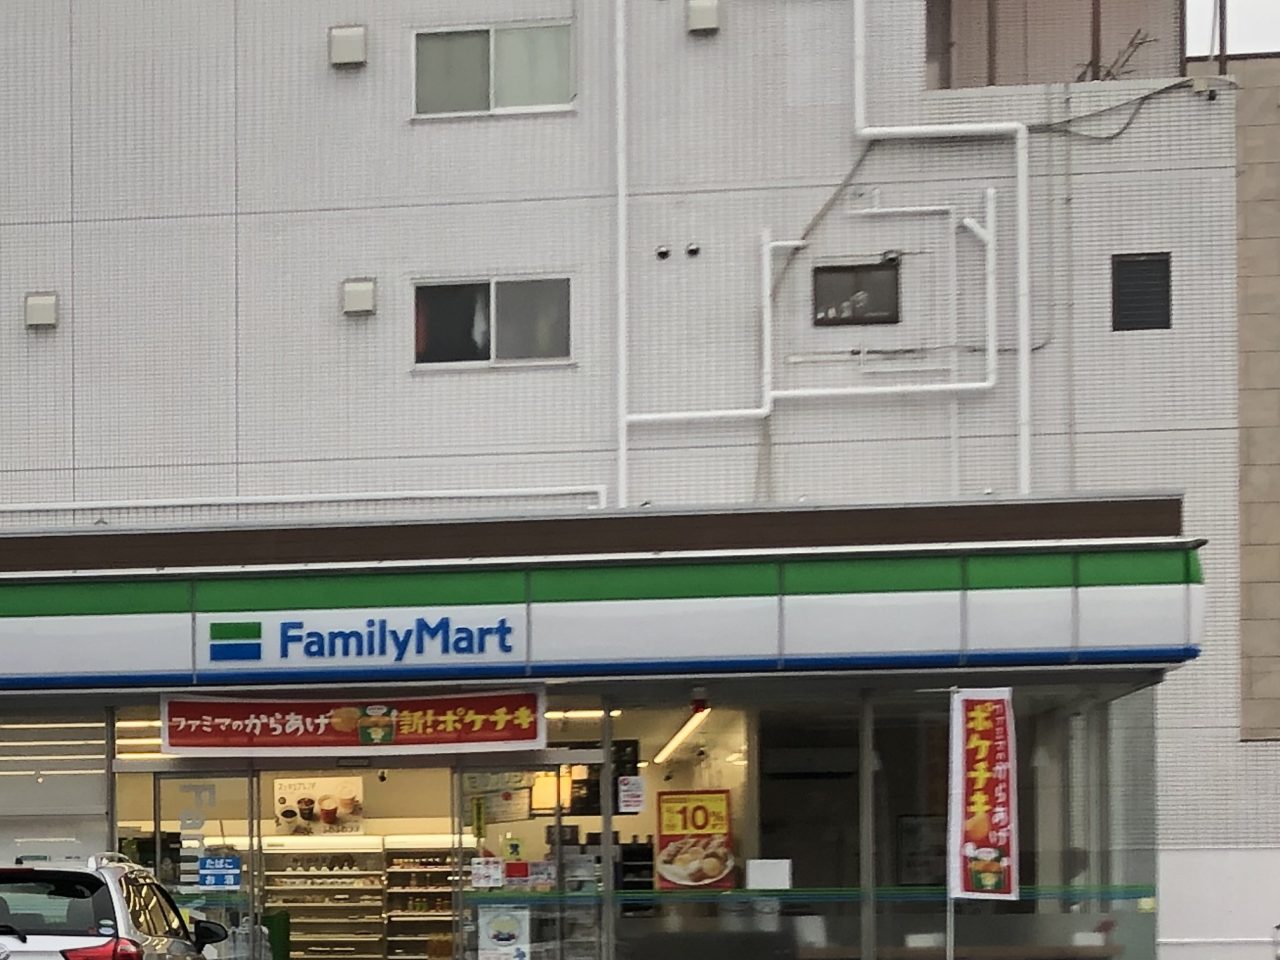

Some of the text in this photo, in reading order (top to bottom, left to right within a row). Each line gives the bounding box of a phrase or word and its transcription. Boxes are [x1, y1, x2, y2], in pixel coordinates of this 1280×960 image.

[280, 617, 513, 661] FamilyMart
[172, 711, 331, 737] ファミマのからあげ
[966, 702, 995, 814] ポケチキ
[205, 858, 234, 869] たばこ
